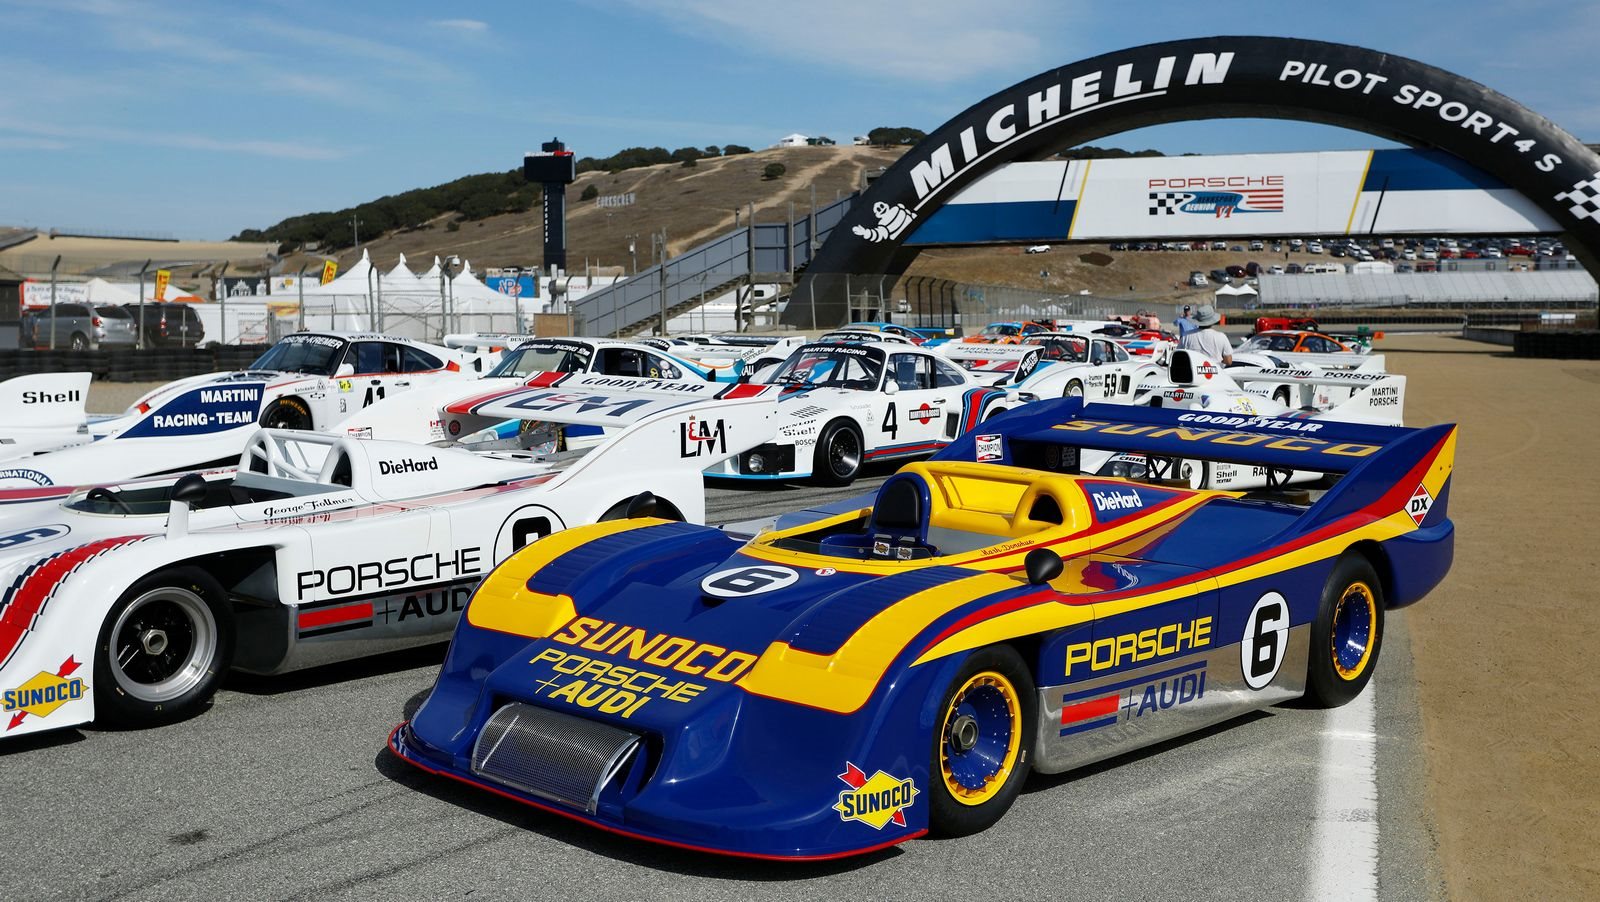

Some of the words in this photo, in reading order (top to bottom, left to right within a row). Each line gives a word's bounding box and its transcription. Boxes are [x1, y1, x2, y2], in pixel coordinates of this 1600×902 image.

[910, 52, 1235, 200] MICHELIN
[1279, 60, 1388, 95] PILOT
[1392, 84, 1520, 144] SPORT
[1513, 138, 1537, 153] 4
[1534, 152, 1563, 173] S
[1149, 176, 1284, 188] PORSCHE
[1216, 205, 1236, 218] VI
[835, 347, 868, 356] RACING
[1259, 368, 1312, 377] MARTINI
[1103, 373, 1117, 398] 59
[1165, 391, 1194, 399] MARTINI
[1371, 387, 1398, 397] MARTINI
[22, 390, 80, 404] Shell
[200, 389, 258, 404] MARTINI
[1369, 397, 1398, 407] PORSCHE
[882, 402, 898, 440] 4
[783, 427, 816, 437] Shell
[1051, 420, 1384, 458] SUNOCO
[795, 438, 816, 447] BOSCH
[978, 443, 1001, 453] CHAMPION
[378, 456, 438, 475] DieHard
[1216, 470, 1238, 479] Shell
[1092, 489, 1143, 511] DieHard
[1411, 497, 1429, 513] DX
[297, 546, 481, 600] PORSCHE
[708, 568, 791, 593] 6
[377, 588, 472, 625] +AUD
[552, 616, 759, 684] SUNOCO
[1064, 615, 1213, 677] PORSCHE
[1250, 602, 1282, 678] 6
[528, 648, 707, 704] PORSCHE
[4, 679, 81, 710] SUNOCO
[842, 781, 911, 818] SUNOCO
